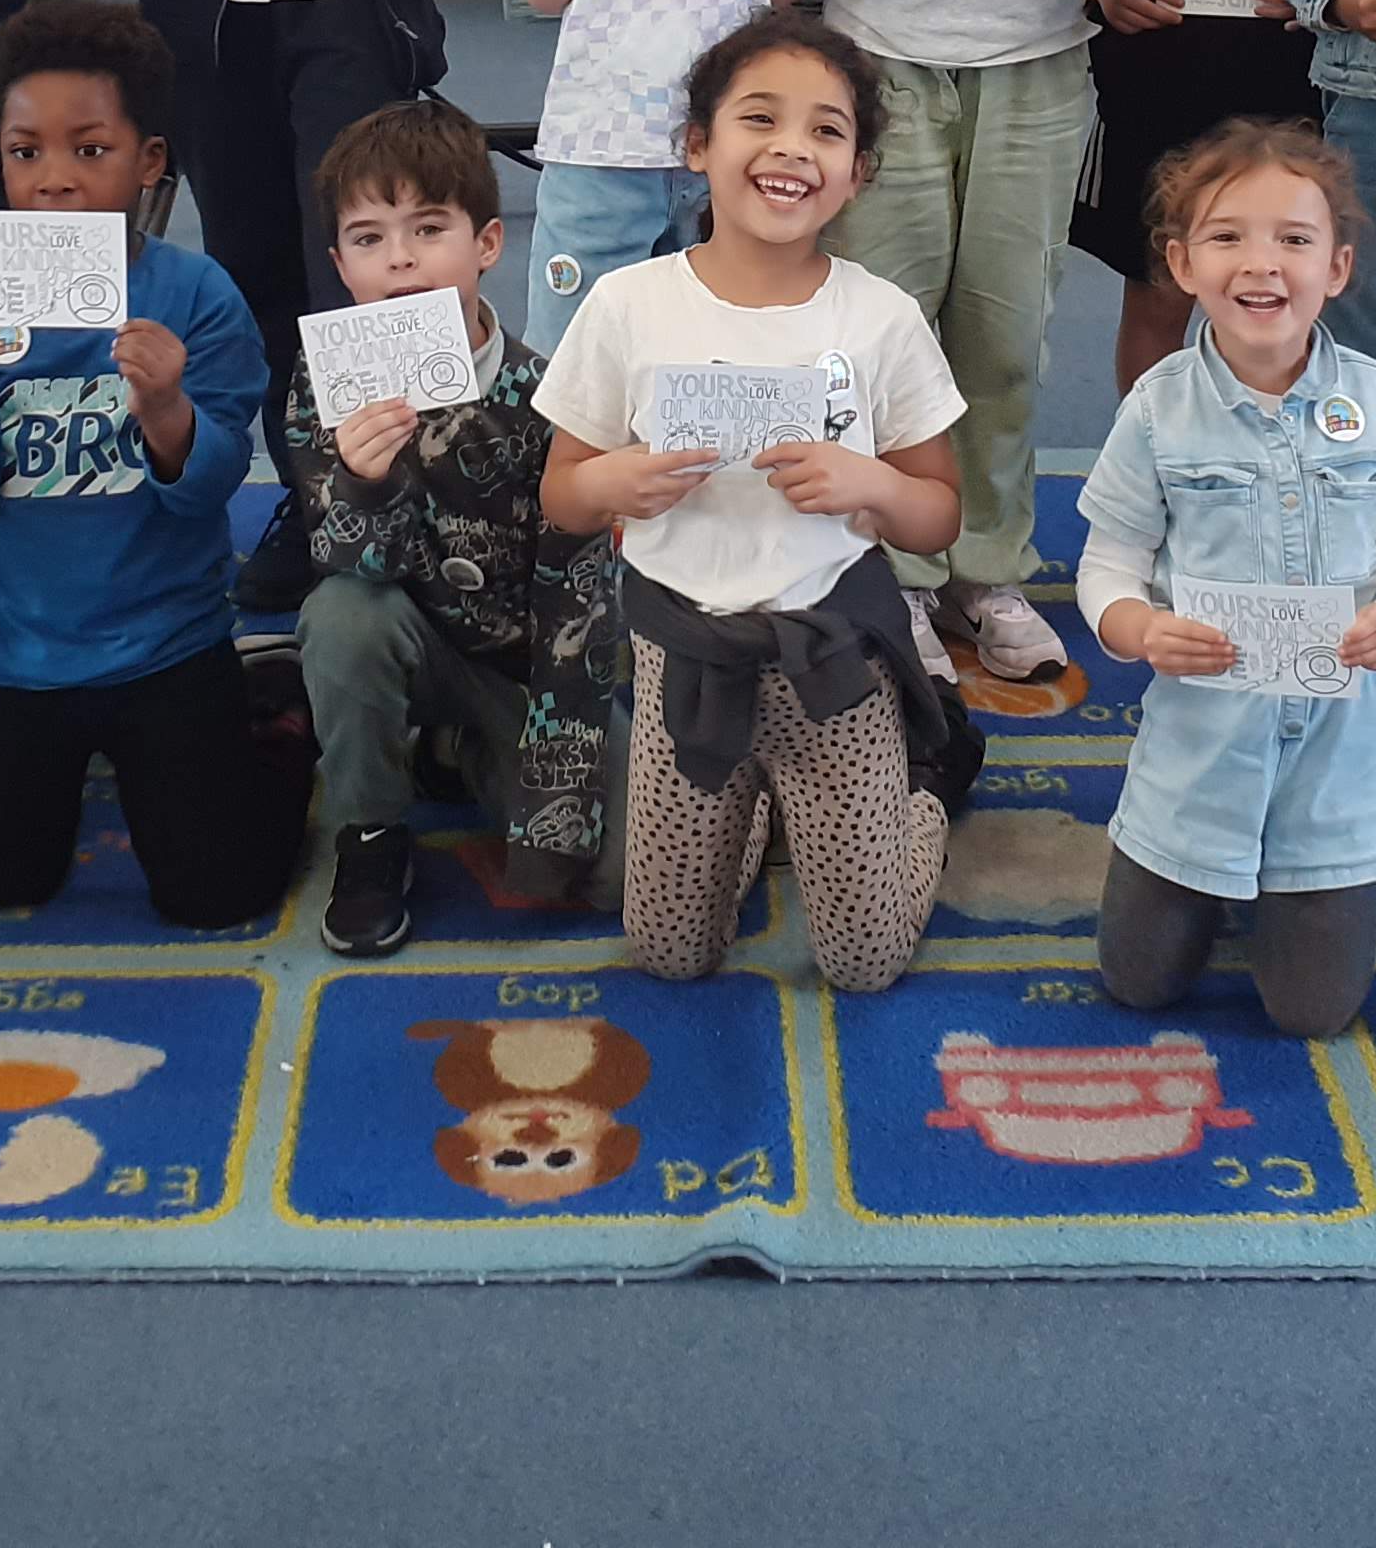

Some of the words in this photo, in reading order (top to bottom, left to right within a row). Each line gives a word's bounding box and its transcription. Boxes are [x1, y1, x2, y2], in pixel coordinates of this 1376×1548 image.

[310, 313, 391, 347] YOURS
[314, 347, 343, 373] OF
[665, 373, 748, 399] YOURS
[659, 398, 692, 421] OF
[698, 398, 816, 425] KINDNESS.
[1183, 588, 1272, 619] YOURS
[497, 976, 601, 1011] dog
[104, 1165, 201, 1209] Ee
[656, 1148, 775, 1201] Dd
[1211, 1155, 1318, 1199] Cc
